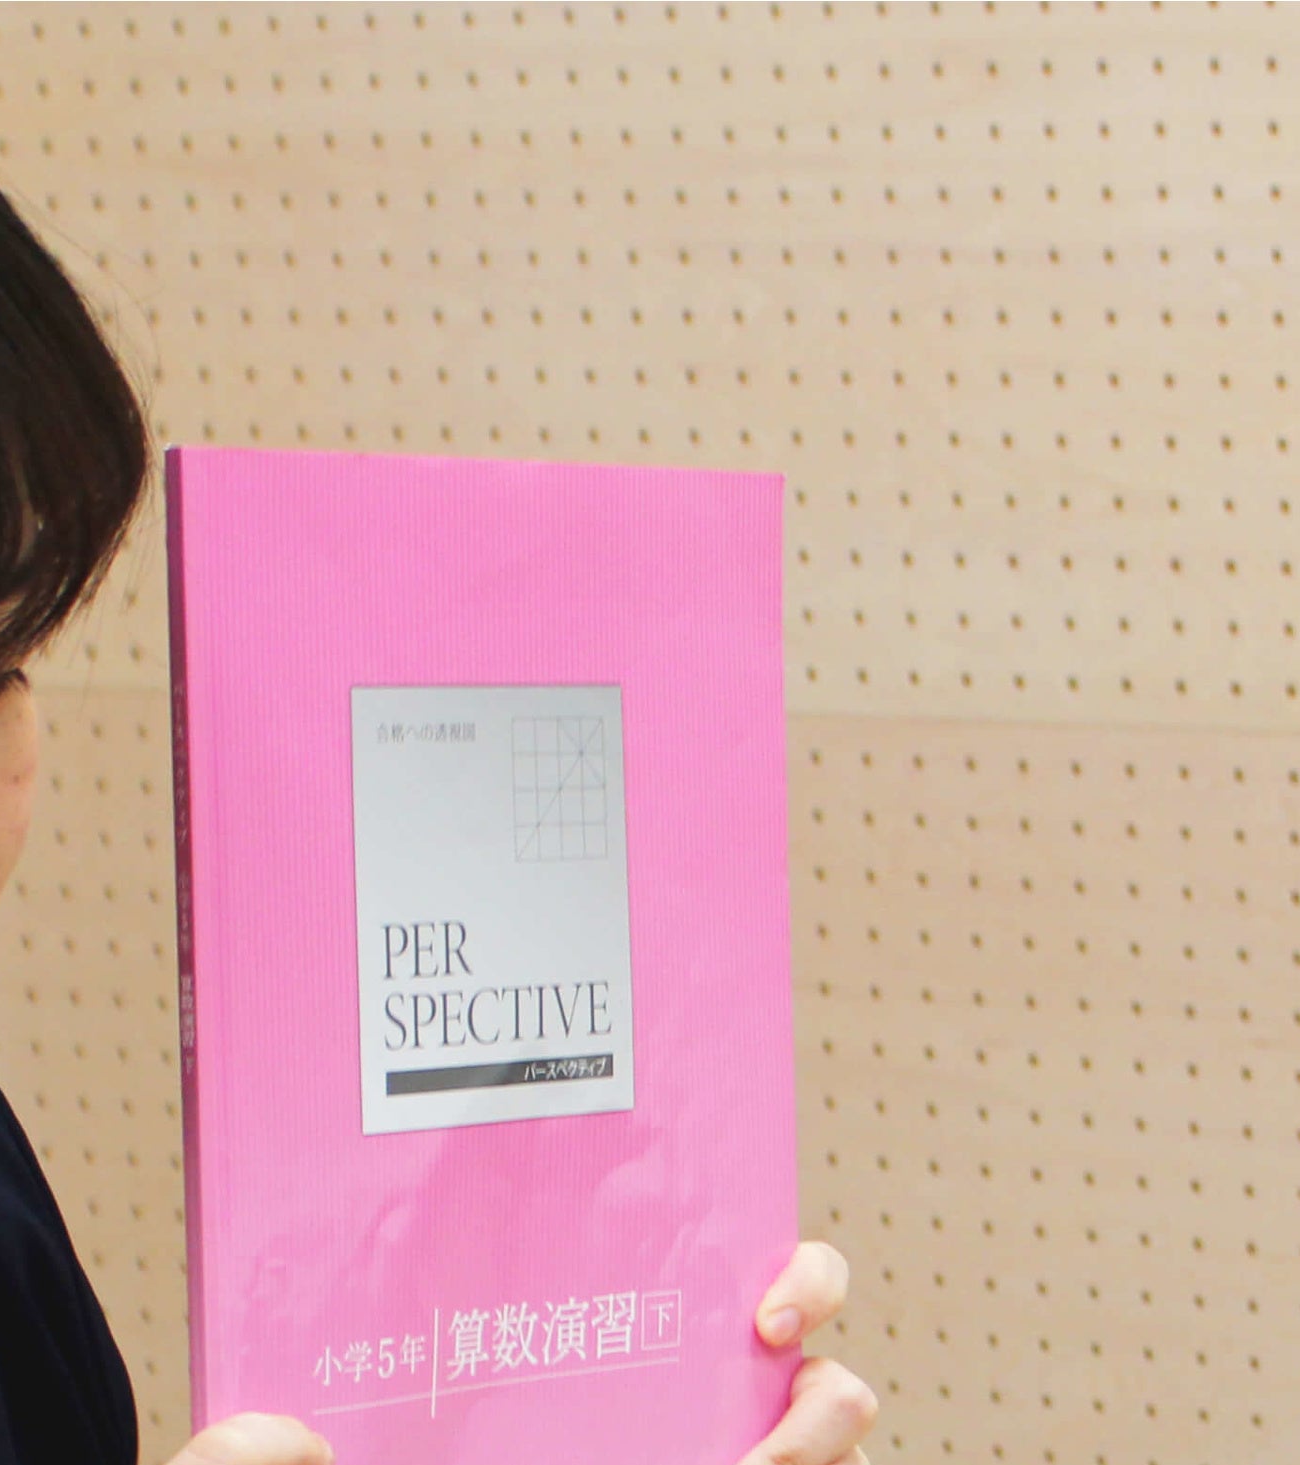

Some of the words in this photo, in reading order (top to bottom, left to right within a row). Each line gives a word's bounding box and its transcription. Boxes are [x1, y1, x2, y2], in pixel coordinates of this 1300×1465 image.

[382, 921, 472, 980] PER
[384, 980, 612, 1051] SPECTIVE
[523, 1056, 607, 1081] パースペクティブ
[314, 1334, 427, 1386] 小学5年
[446, 1290, 638, 1382] 算数演習
